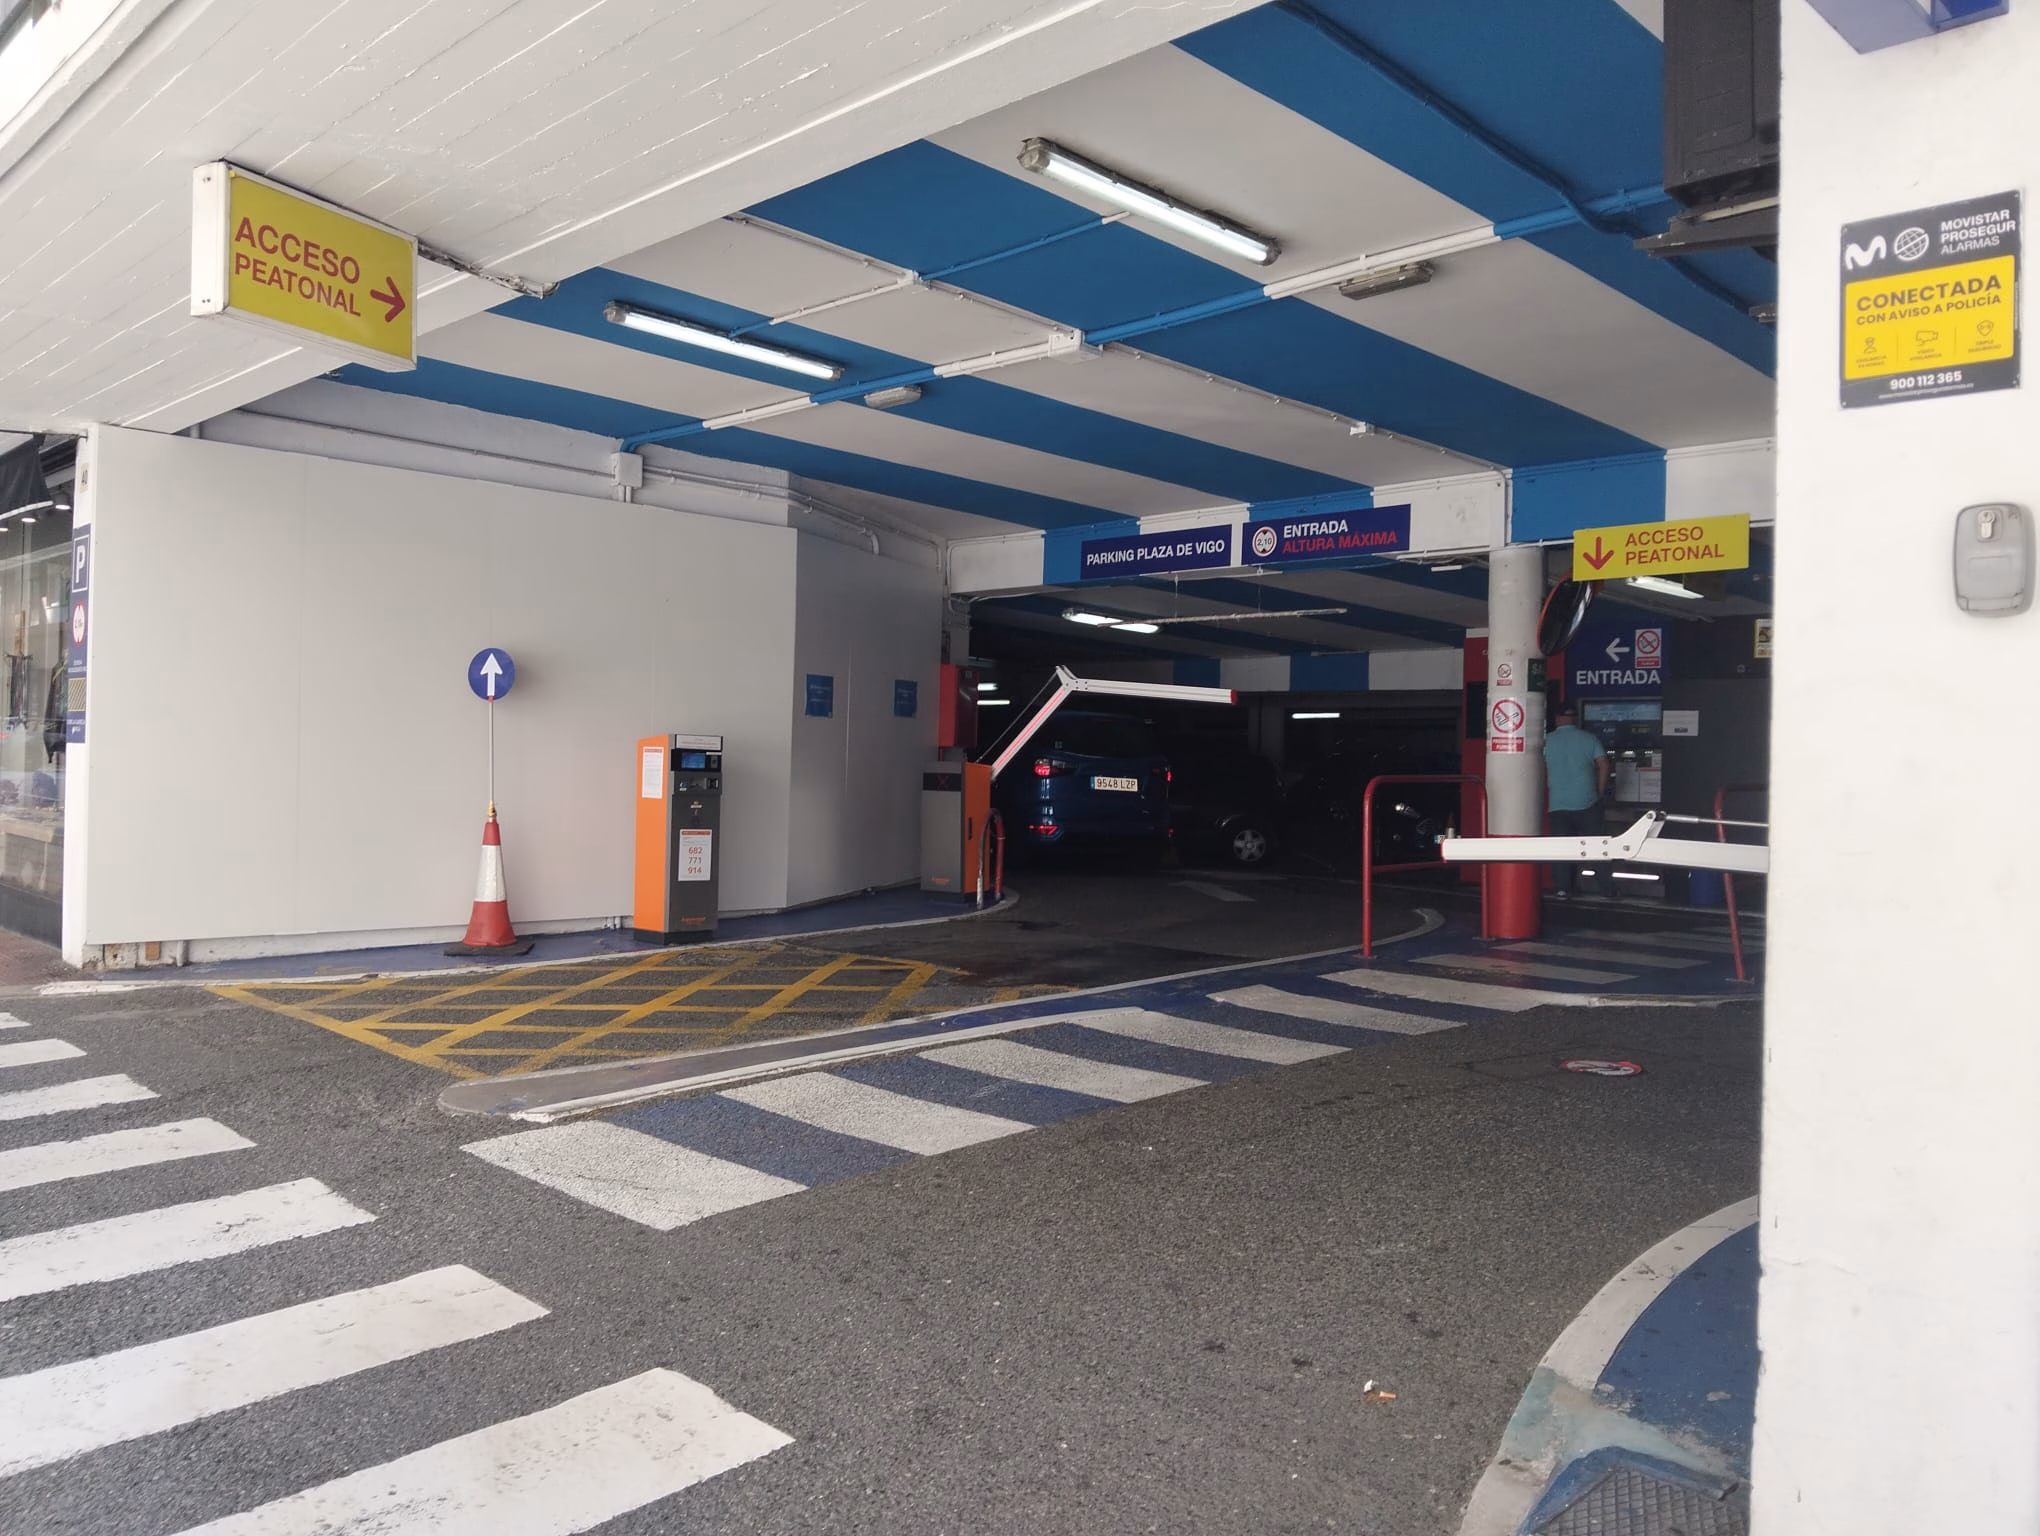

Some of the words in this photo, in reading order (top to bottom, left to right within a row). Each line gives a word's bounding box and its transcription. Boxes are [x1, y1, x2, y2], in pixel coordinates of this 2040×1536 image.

[1941, 209, 2010, 231] MOVISTAR
[1941, 220, 2016, 243] PROSEGUR
[234, 216, 360, 284] ACCESO
[1940, 235, 2000, 255] ALARMAS
[234, 252, 361, 317] PEATONAL
[1856, 275, 2002, 312] CONECTADA
[1856, 312, 1886, 326] CON
[1888, 305, 1930, 321] AVISO
[1933, 303, 1943, 314] A
[1946, 293, 2001, 312] POLICÍA
[1889, 377, 1915, 391] 900
[1917, 374, 1935, 387] 112
[1936, 370, 1962, 385] 365
[1283, 519, 1348, 538] ENTRADA
[1625, 526, 1704, 548] ACCESO
[1086, 549, 1135, 566] PARKING
[1137, 545, 1174, 560] PLAZA
[1176, 543, 1193, 557] DE
[1195, 539, 1225, 554] VIGO
[1282, 537, 1335, 554] ALTURA
[1625, 543, 1725, 566] PEATONAL
[75, 545, 86, 584] P
[1576, 670, 1661, 685] ENTRADA
[1097, 778, 1118, 789] 9548
[1120, 779, 1136, 789] LZP
[688, 846, 703, 855] 682
[688, 856, 702, 865] 771
[687, 866, 702, 874] 914
